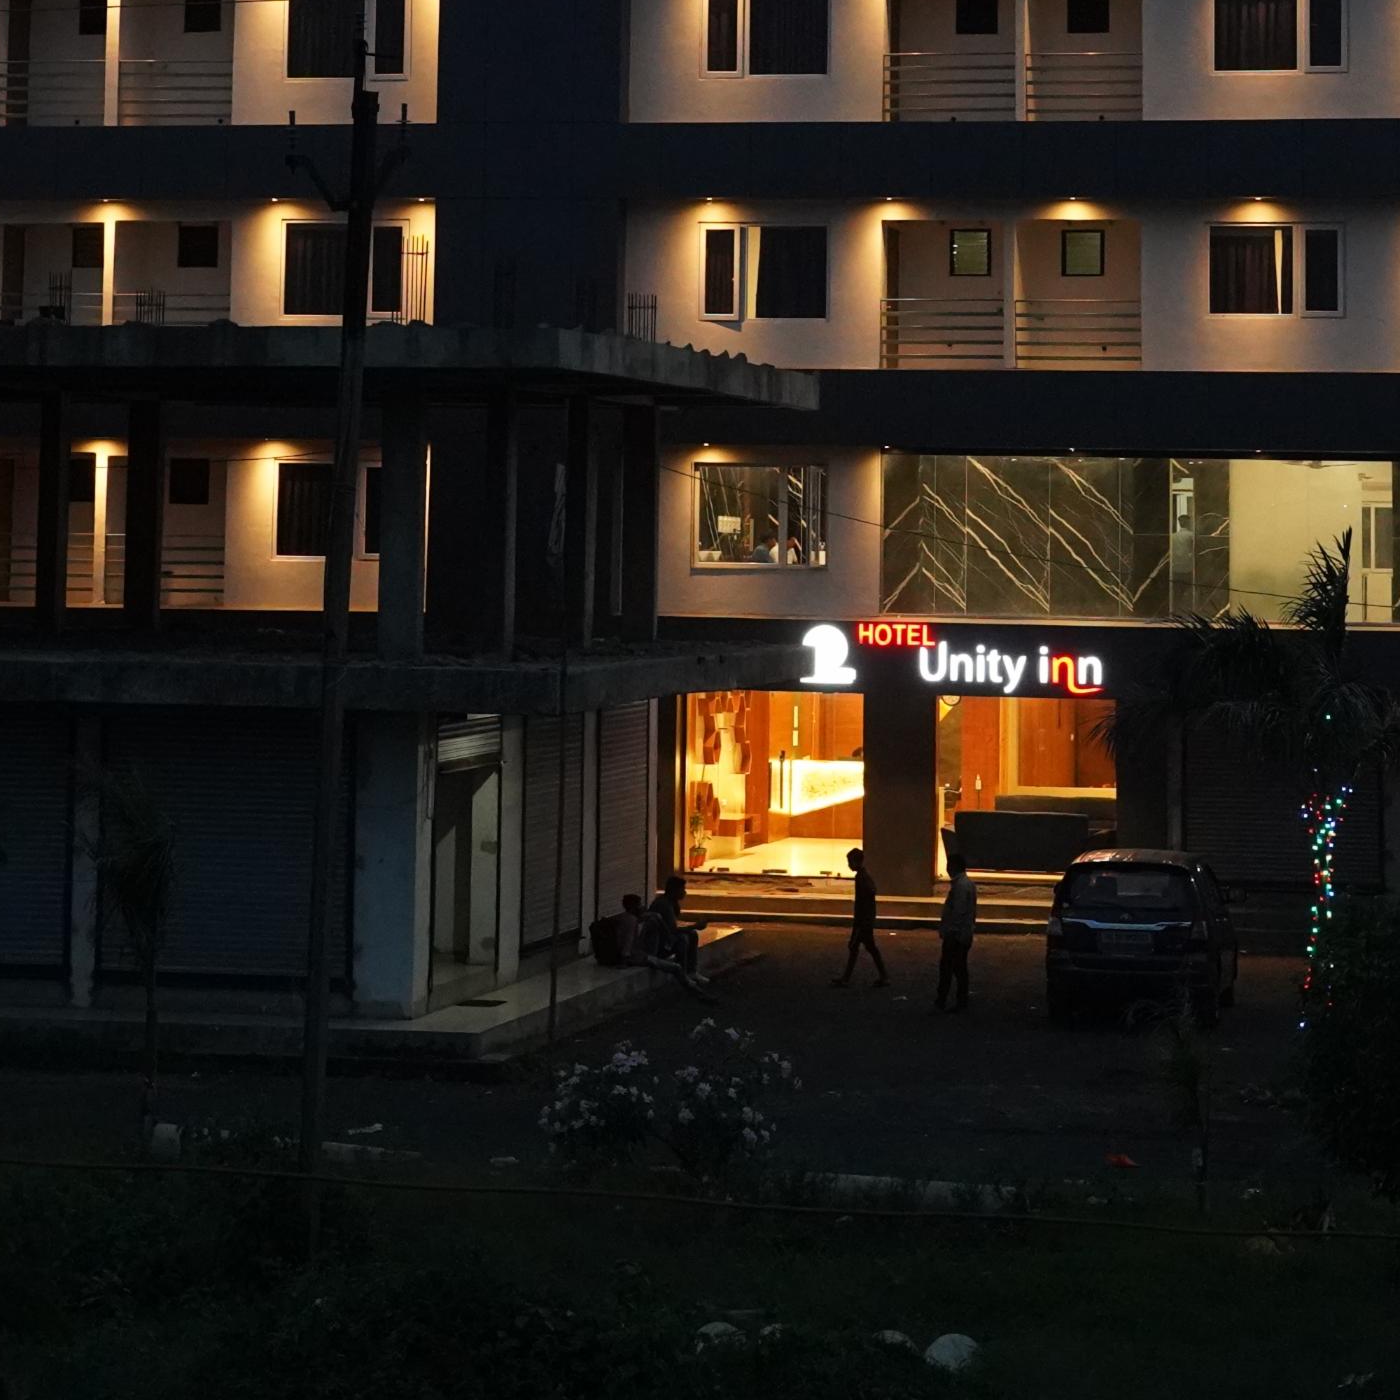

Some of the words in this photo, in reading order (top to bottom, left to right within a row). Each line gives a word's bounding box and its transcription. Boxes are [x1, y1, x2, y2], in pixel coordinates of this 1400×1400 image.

[858, 623, 936, 646] HOTEL
[919, 641, 1028, 694] Unity
[1039, 646, 1105, 694] inn
